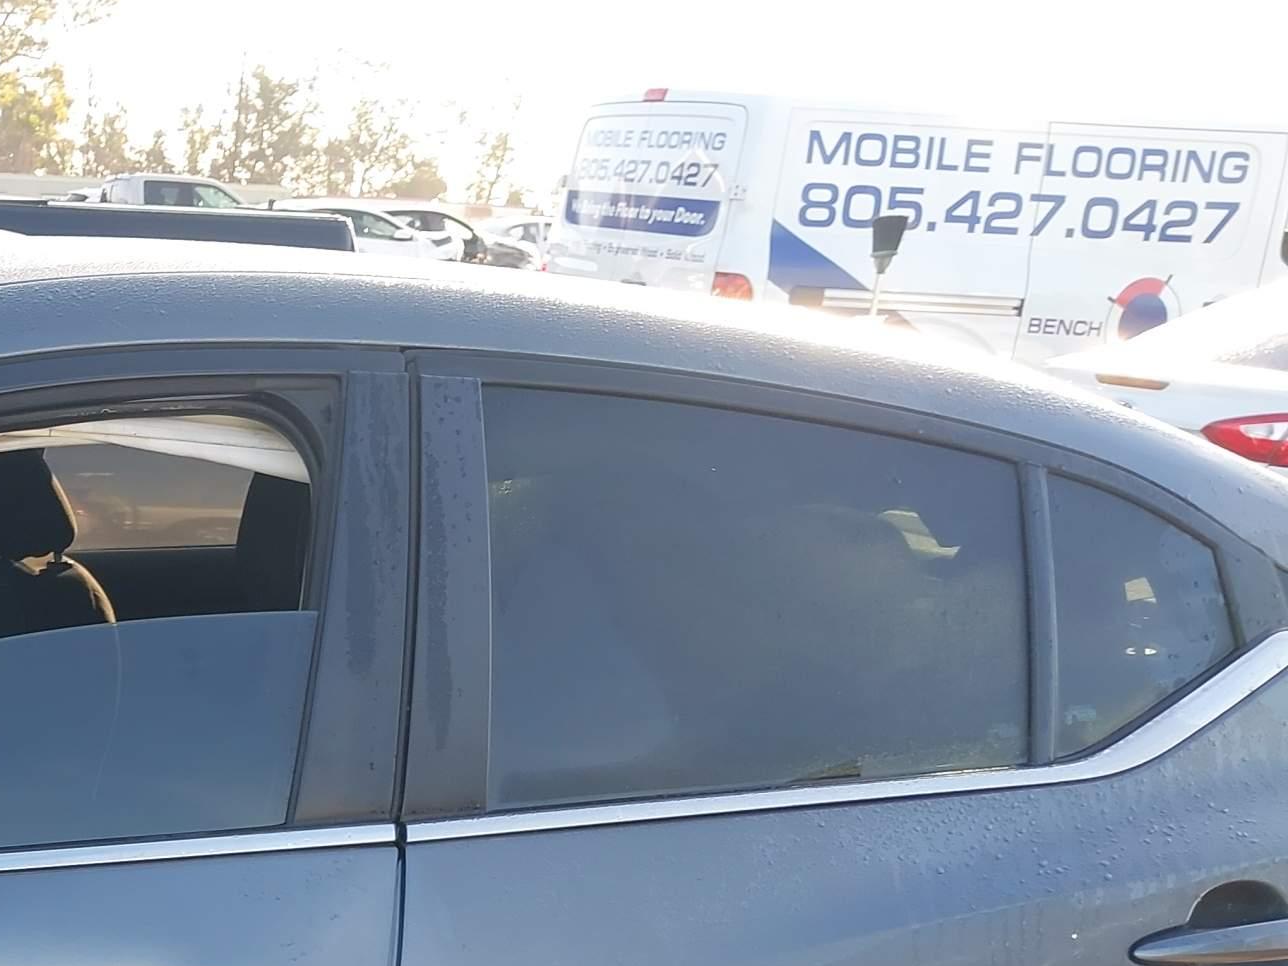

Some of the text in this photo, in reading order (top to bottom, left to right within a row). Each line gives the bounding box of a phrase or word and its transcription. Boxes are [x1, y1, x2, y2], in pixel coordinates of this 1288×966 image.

[637, 130, 727, 151] FLOORING
[806, 129, 1250, 184] MOBILE FLOORING
[579, 158, 720, 188] 805.427.0427
[615, 202, 639, 218] Floor
[639, 205, 650, 220] to
[648, 209, 674, 224] your
[674, 206, 706, 225] Door.
[798, 182, 1241, 243] 805.427.0427
[1027, 318, 1103, 337] BENCH
